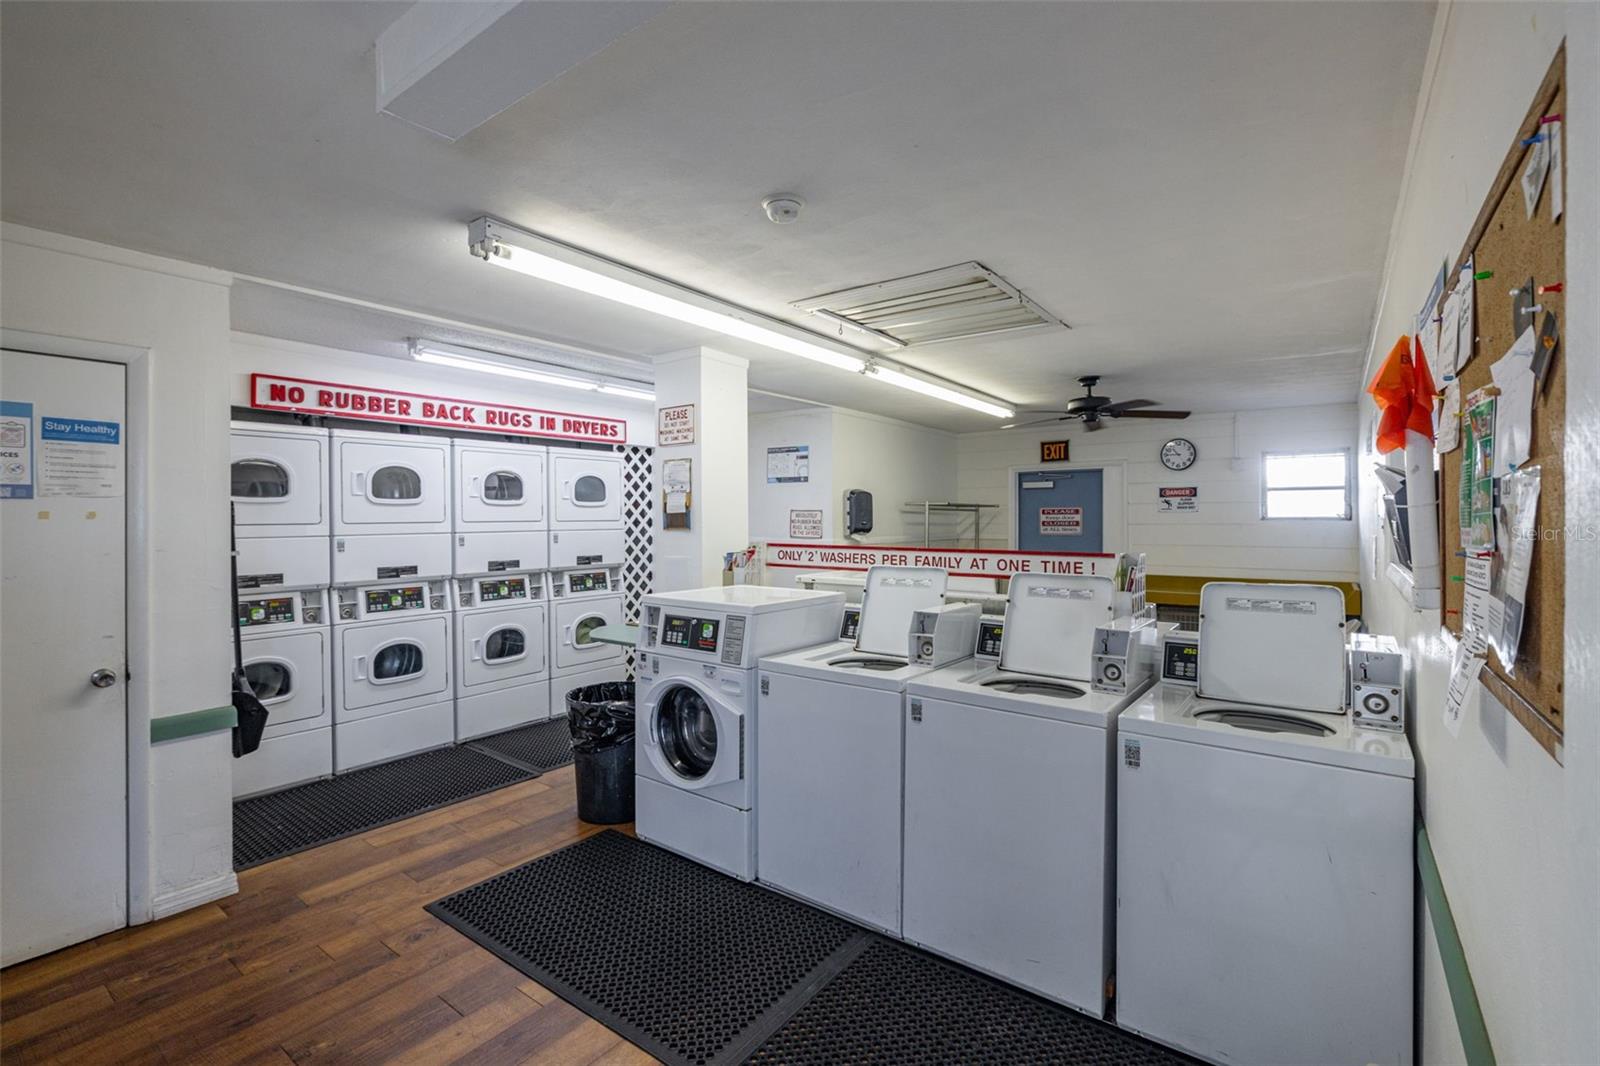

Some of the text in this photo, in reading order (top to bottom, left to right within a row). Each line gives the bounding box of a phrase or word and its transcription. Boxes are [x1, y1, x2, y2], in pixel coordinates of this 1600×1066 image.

[270, 383, 618, 437] NO RUBBER BACK RUGS IN DRYERS
[664, 409, 688, 421] PLEASE
[45, 421, 117, 436] Stay Healthy
[1043, 443, 1066, 460] EXIT
[777, 550, 803, 561] ONLY
[819, 552, 876, 565] WASHERS
[881, 554, 907, 566] PER
[914, 555, 963, 569] FAMILY
[969, 557, 988, 570] AT
[996, 558, 1031, 572] ONE
[1041, 560, 1083, 574] TIME
